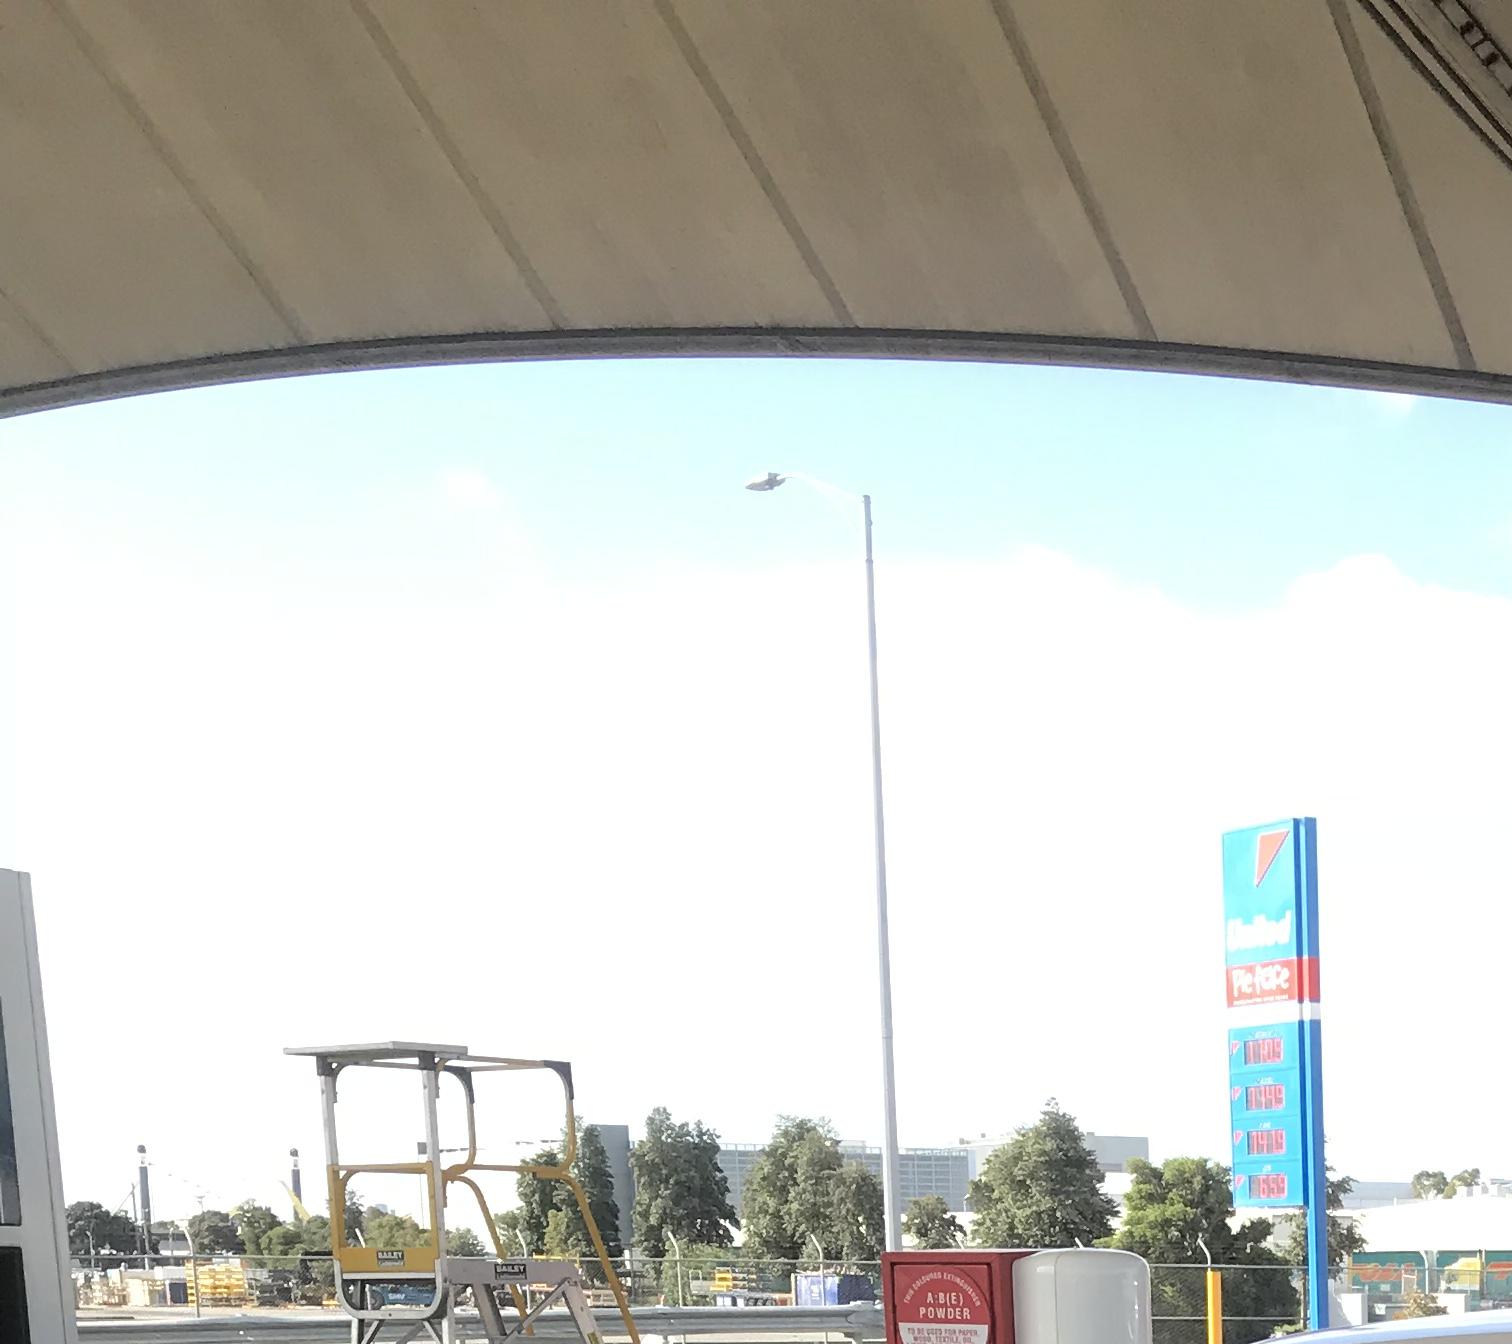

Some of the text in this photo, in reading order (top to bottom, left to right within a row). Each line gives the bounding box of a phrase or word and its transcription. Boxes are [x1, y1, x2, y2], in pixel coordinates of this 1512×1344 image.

[378, 1251, 402, 1260] BAILEY
[496, 1264, 525, 1273] BAILEY
[919, 1306, 971, 1320] POWDER
